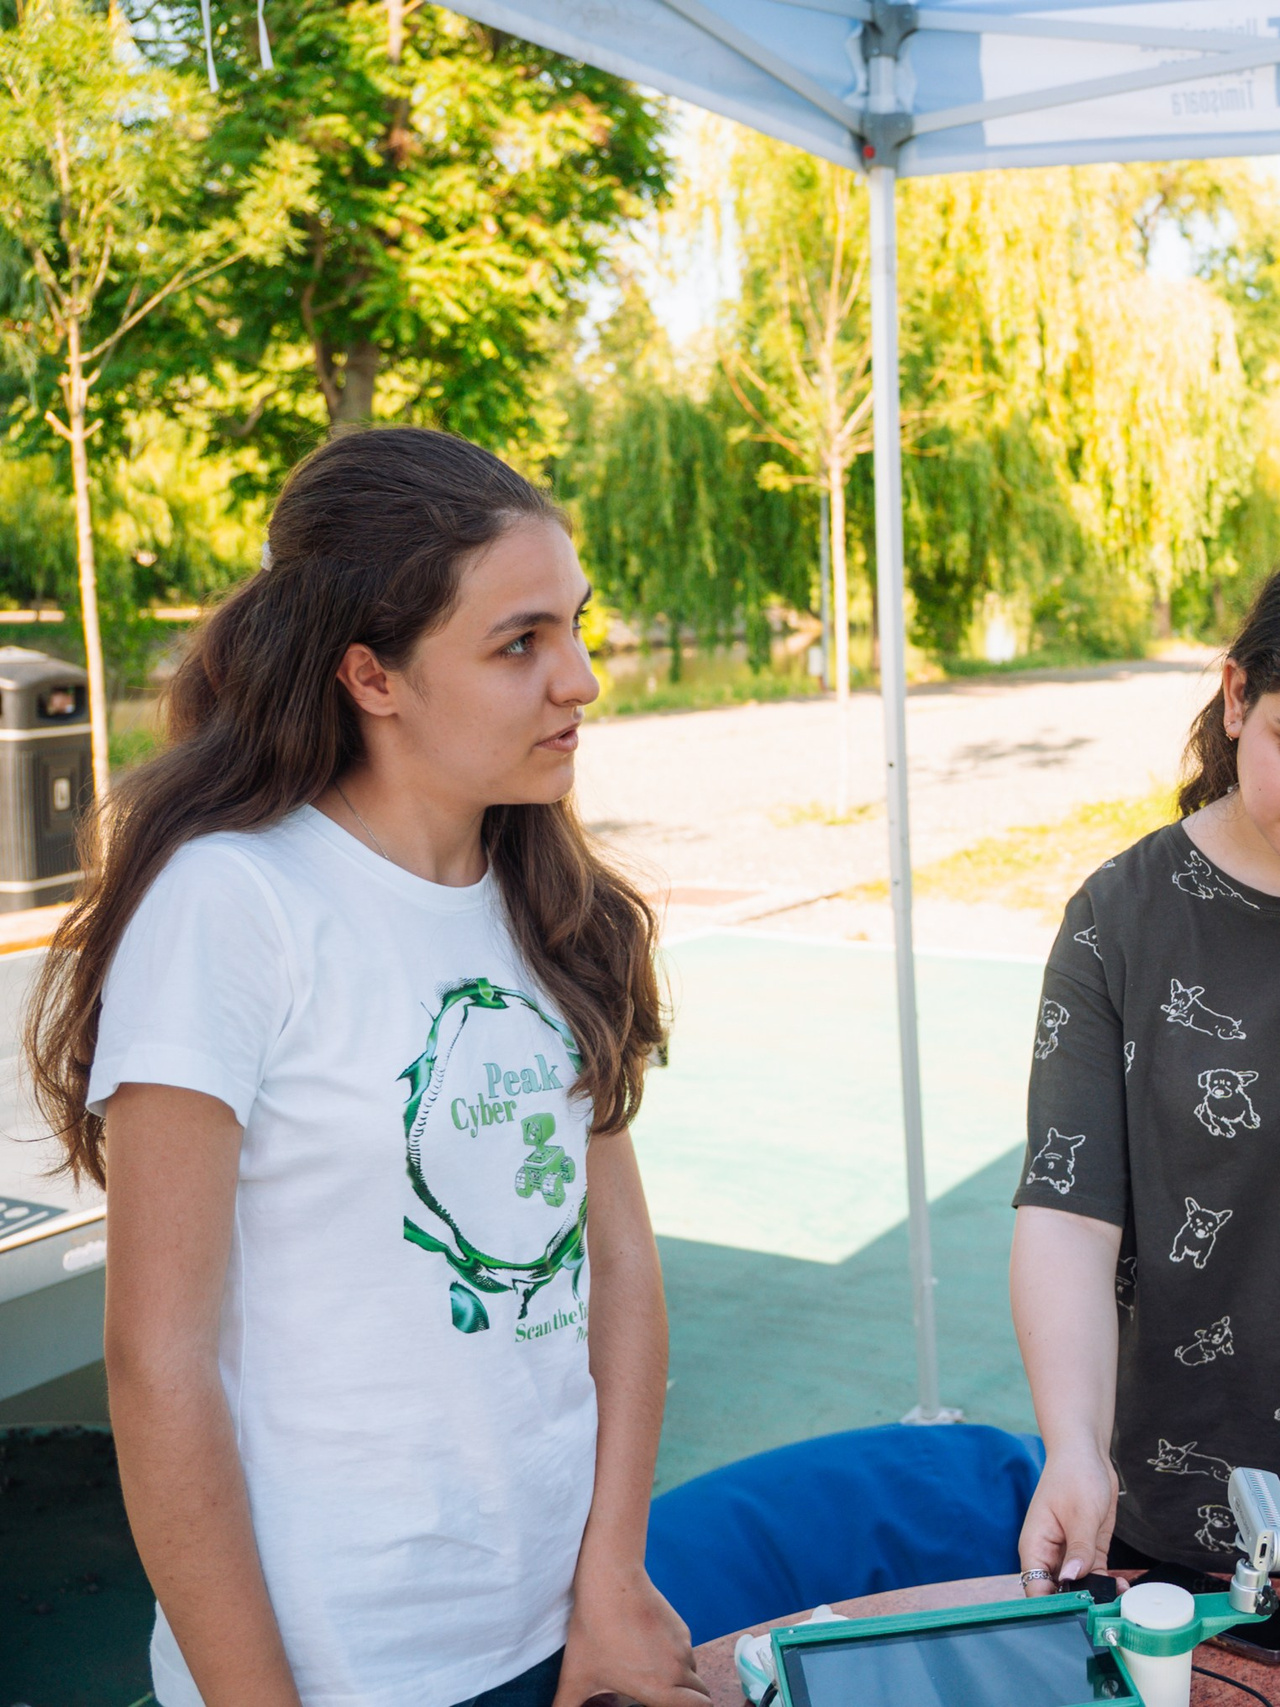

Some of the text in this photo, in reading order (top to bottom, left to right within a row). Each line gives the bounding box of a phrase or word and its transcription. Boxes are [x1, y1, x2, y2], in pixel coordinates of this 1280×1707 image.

[482, 1054, 564, 1098] Peak
[451, 1093, 517, 1138] Cyber
[515, 1322, 552, 1343] Scan
[553, 1308, 578, 1330] the
